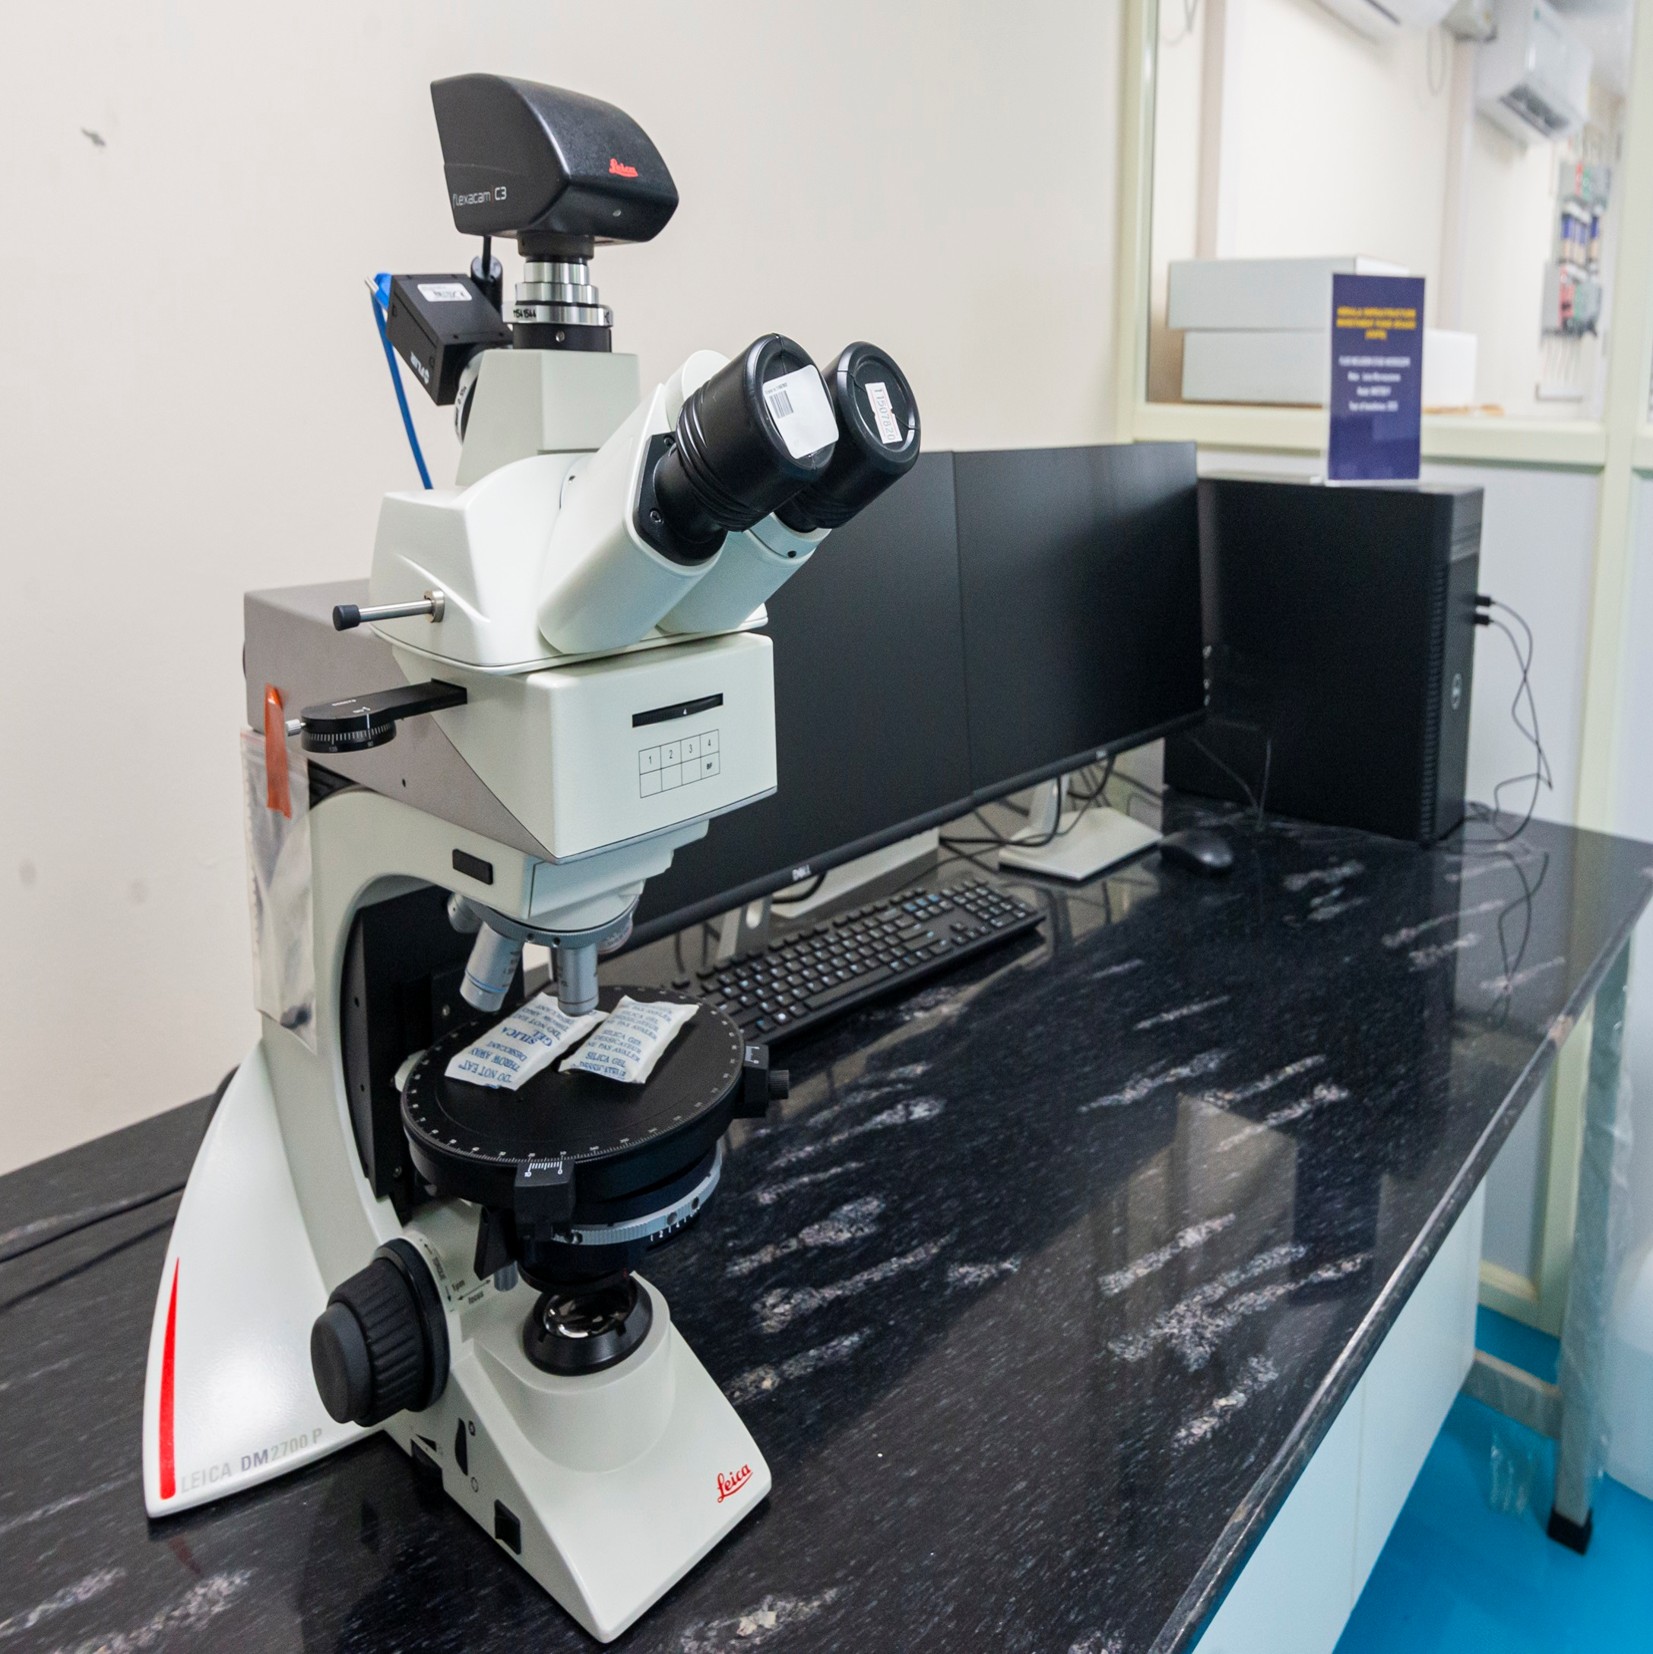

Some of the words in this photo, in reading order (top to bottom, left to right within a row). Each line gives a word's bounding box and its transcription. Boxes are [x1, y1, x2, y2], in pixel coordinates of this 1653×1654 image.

[494, 186, 507, 200] C3
[669, 749, 673, 760] 2
[689, 743, 693, 754] 3
[502, 1027, 538, 1045] SILICA
[533, 1030, 553, 1046] GEL
[585, 1051, 610, 1063] SILICA
[612, 1057, 625, 1068] GEL
[180, 1462, 233, 1494] LEICA
[240, 1434, 308, 1472] DM2700
[312, 1427, 322, 1444] P
[717, 1464, 753, 1503] Leica
